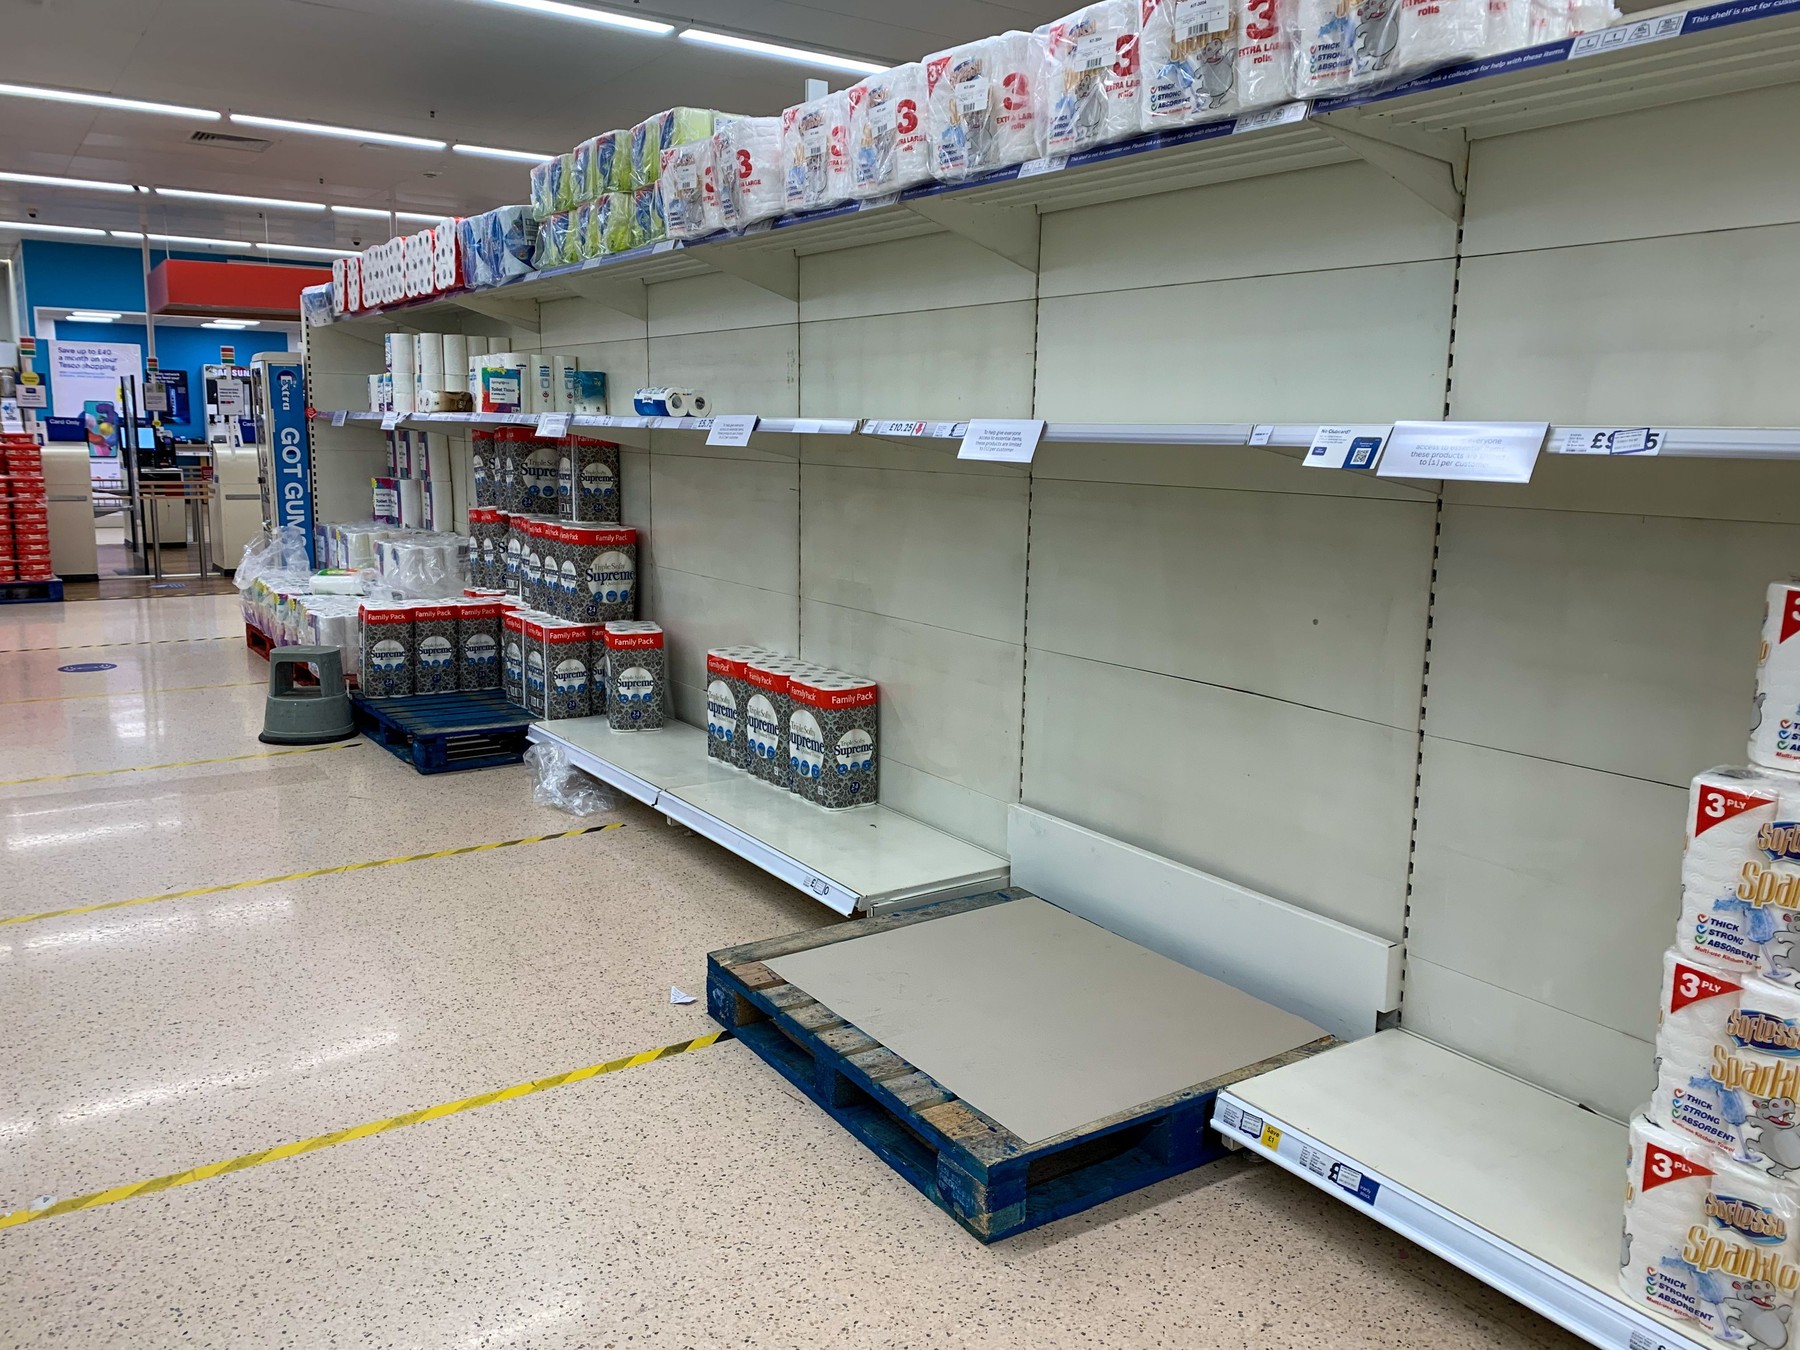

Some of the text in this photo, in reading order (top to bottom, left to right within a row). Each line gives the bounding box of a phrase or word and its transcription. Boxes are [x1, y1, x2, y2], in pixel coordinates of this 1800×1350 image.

[1417, 6, 1440, 17] rolls
[1692, 15, 1709, 24] This
[1710, 9, 1732, 20] shelf
[1741, 4, 1758, 13] not
[1758, 1, 1772, 10] for
[1318, 42, 1341, 52] THICK
[1410, 78, 1430, 88] Please
[1448, 67, 1479, 80] colleague
[1490, 61, 1506, 71] help
[1506, 57, 1522, 66] with
[1523, 53, 1543, 62] these
[1543, 48, 1566, 57] items.
[897, 99, 918, 135] 3
[1184, 131, 1195, 139] help
[736, 149, 753, 179] 3
[58, 347, 75, 355] Save
[76, 348, 88, 356] up
[280, 375, 293, 411] Extra
[889, 423, 914, 433] £10.25
[280, 427, 303, 478] GOT
[1430, 451, 1465, 460] products
[1427, 459, 1440, 467] [1]
[1440, 460, 1454, 468] per
[520, 463, 558, 480] Supre
[580, 473, 614, 485] Supreme
[595, 535, 615, 543] Family
[585, 568, 635, 586] Supreme
[368, 613, 389, 621] Family
[415, 609, 452, 619] Family Pack
[461, 609, 482, 617] Family
[549, 630, 586, 640] Family Pack
[614, 638, 654, 647] Family Pack
[370, 649, 406, 660] Supreme
[419, 645, 453, 657] Supreme
[464, 644, 497, 655] Supreme
[553, 671, 587, 682] Supreme
[617, 679, 655, 690] Supreme
[791, 686, 817, 702] Family Pack
[831, 693, 873, 705] Family Pack
[834, 743, 874, 758] Supreme
[1704, 792, 1747, 818] 3 PLY
[1736, 861, 1800, 909] Spar
[1710, 918, 1740, 932] THICK
[1708, 929, 1745, 946] STRONG
[1693, 945, 1722, 959] Multi-use
[1707, 939, 1761, 962] ABSORBENT
[1679, 973, 1722, 998] 3 PLY
[1711, 1045, 1800, 1104] Sparkl
[1686, 1094, 1713, 1111] THICK
[1683, 1104, 1721, 1126] STRONG
[1266, 1126, 1280, 1138] Save
[1681, 1116, 1736, 1143] ABSORBENT
[1267, 1136, 1275, 1144] £1
[1694, 1130, 1716, 1145] Kitchen
[1716, 1140, 1736, 1153] Towel
[1651, 1153, 1673, 1178] 3
[1705, 1193, 1787, 1238] Softesse
[1659, 1273, 1688, 1290] THICK
[1658, 1282, 1696, 1305] STRONG
[1657, 1292, 1714, 1322] ABSORBENT
